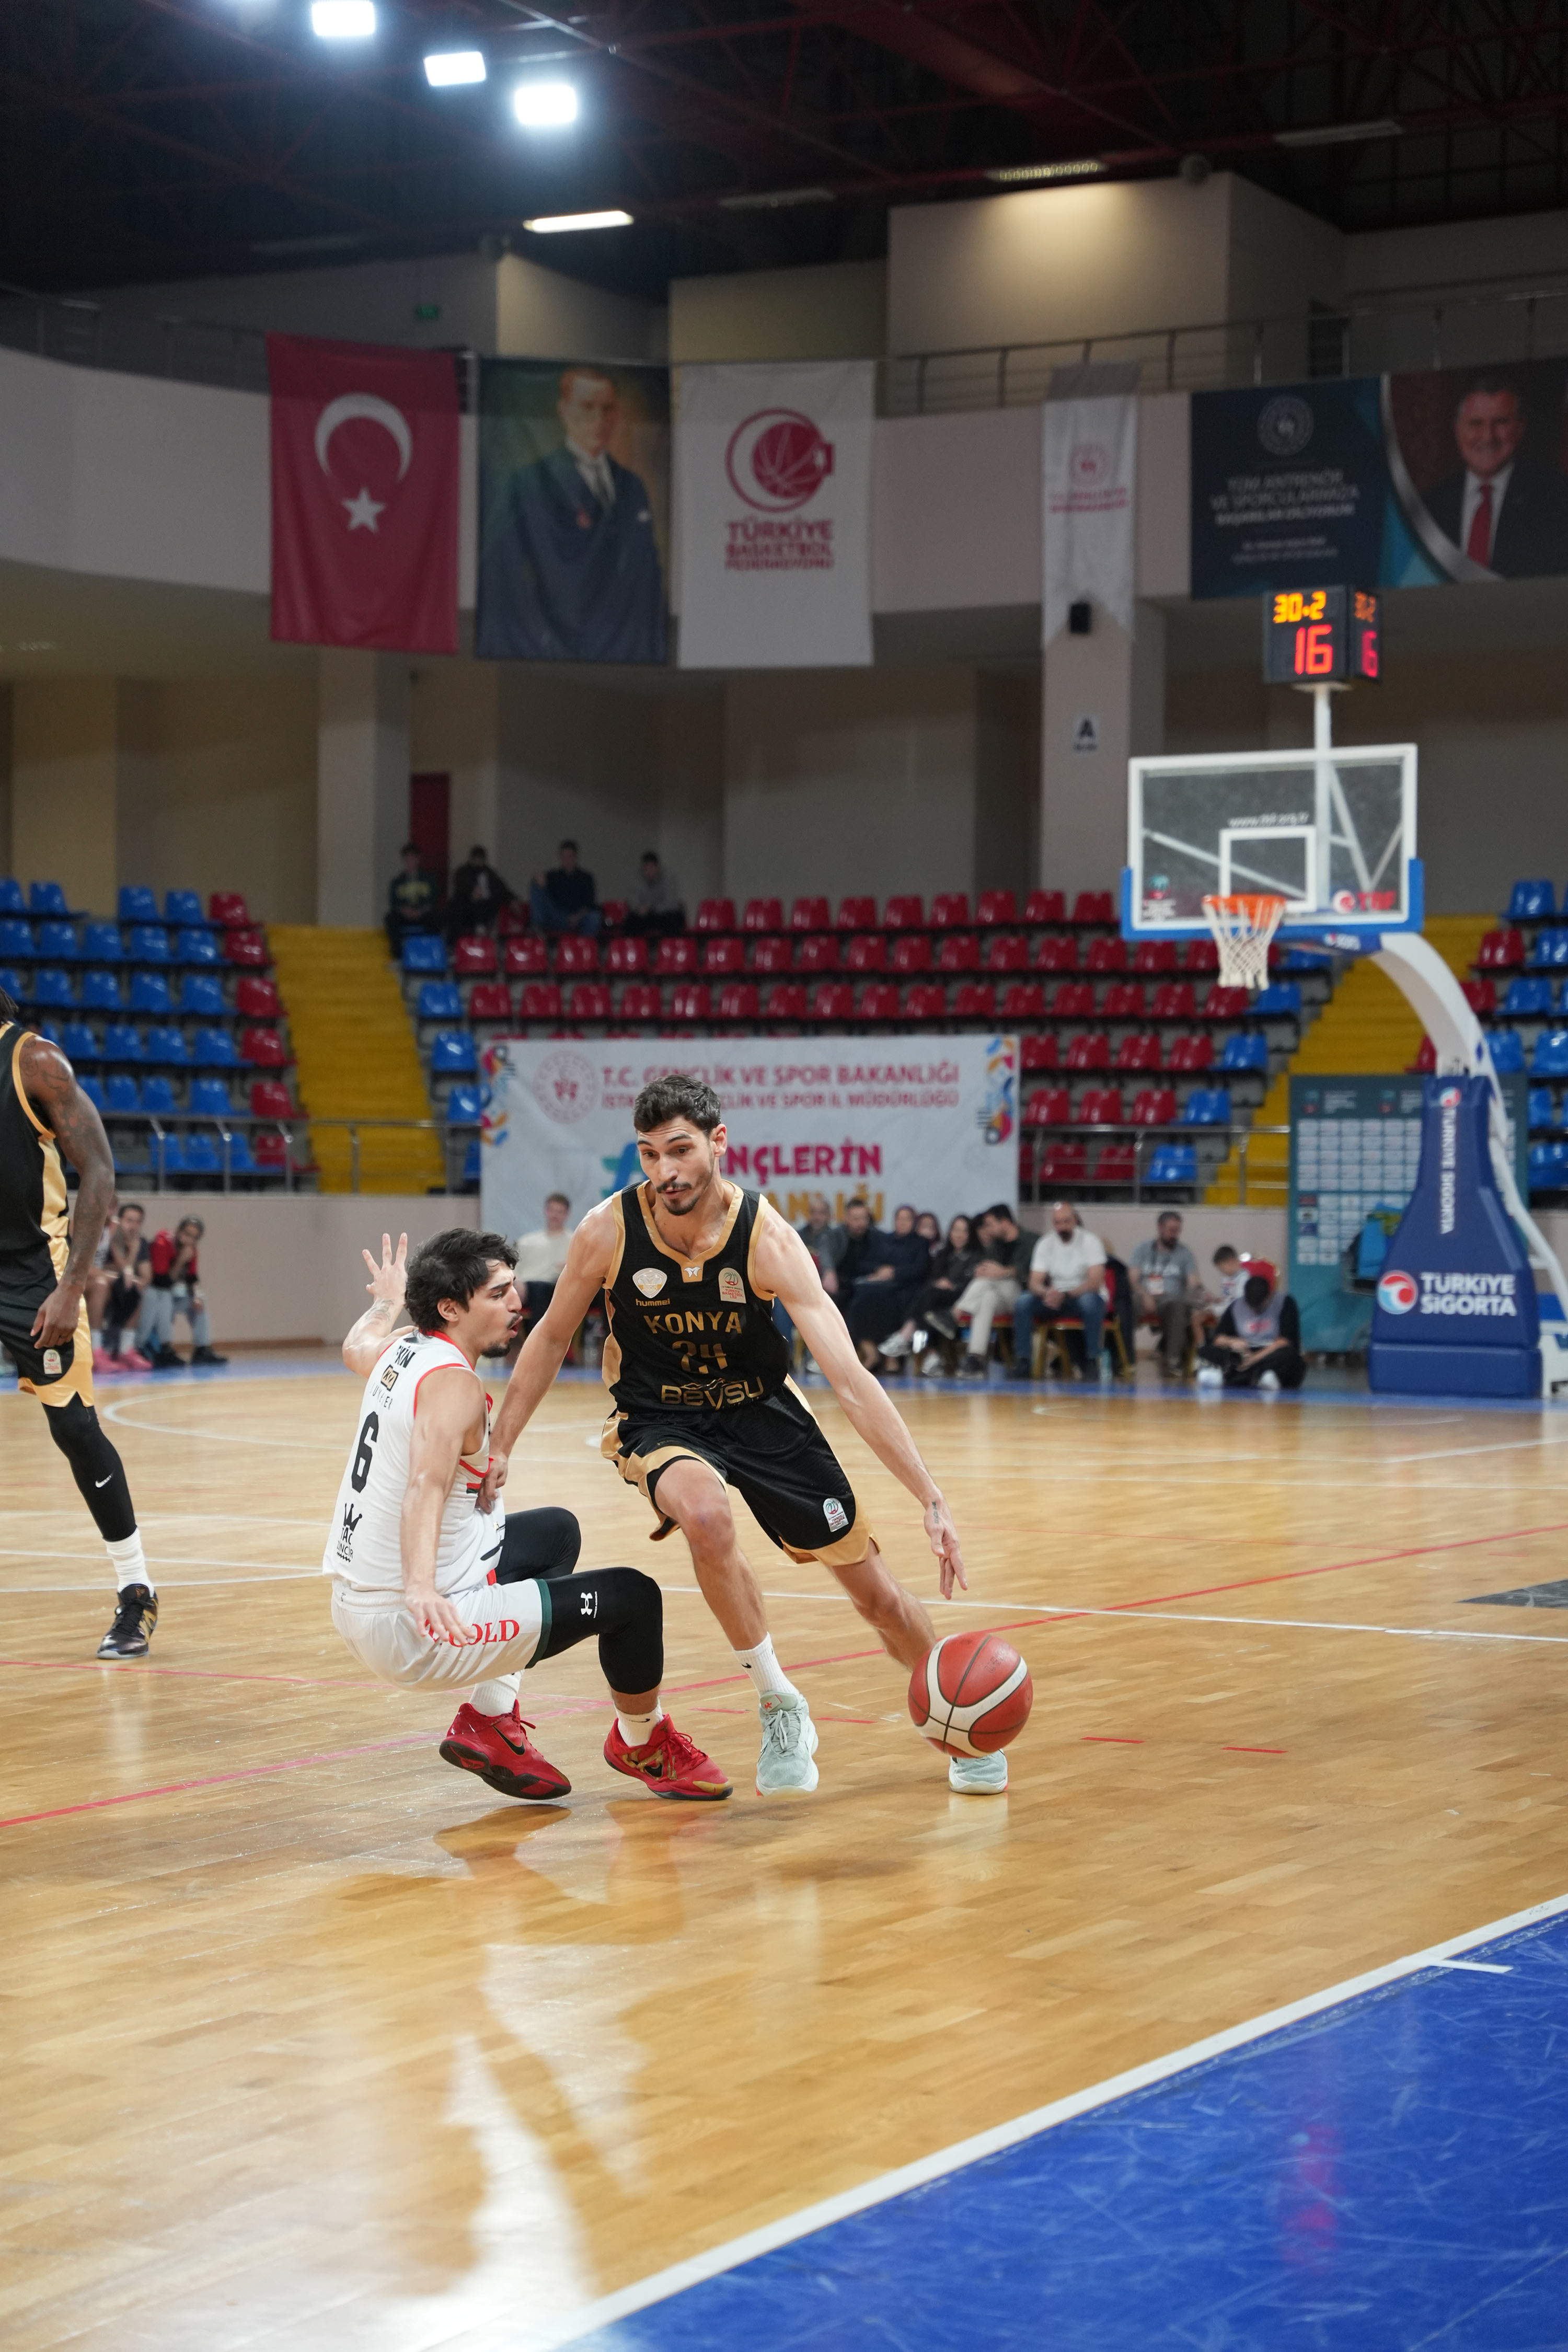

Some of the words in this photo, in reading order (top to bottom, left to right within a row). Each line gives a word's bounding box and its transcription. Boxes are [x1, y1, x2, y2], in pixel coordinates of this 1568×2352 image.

[728, 514, 833, 541] TÜRKİYE
[1273, 591, 1327, 623] 30.2
[1295, 624, 1333, 675] 16
[602, 1066, 637, 1088] T.C.
[740, 1065, 767, 1087] VE
[774, 1065, 831, 1087] SPOR
[837, 1059, 960, 1086] BAKANLIĞI
[757, 1093, 779, 1109] VE
[782, 1092, 825, 1109] SPOR
[719, 1137, 882, 1186] NÇLERİN
[1420, 1272, 1516, 1296] TÜRKİYE
[635, 1298, 670, 1307] hummel
[1421, 1294, 1517, 1317] SİGORTA
[643, 1311, 743, 1335] KONYA
[672, 1340, 728, 1374] 24
[351, 1411, 378, 1493] 6
